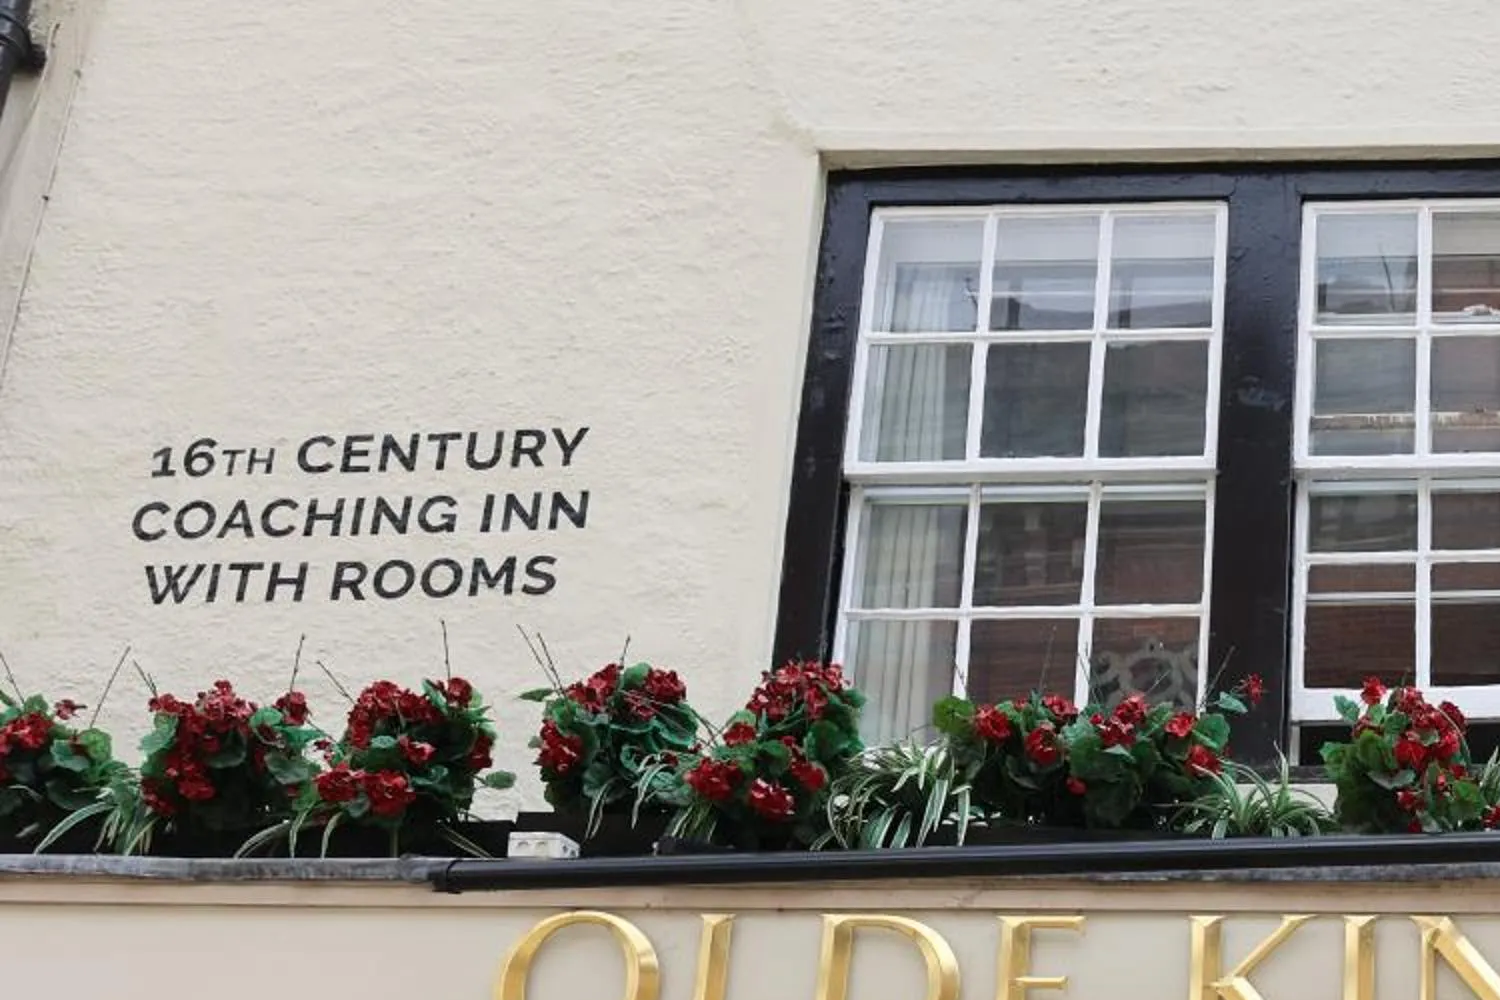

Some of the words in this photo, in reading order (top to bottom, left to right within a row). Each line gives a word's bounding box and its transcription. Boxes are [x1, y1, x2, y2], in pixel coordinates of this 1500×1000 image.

[150, 437, 275, 477] 16TH
[296, 427, 590, 474] CENTURY
[131, 494, 458, 541] COACHING
[479, 490, 590, 533] INN
[143, 561, 308, 605] WITH
[329, 555, 557, 600] ROOMS
